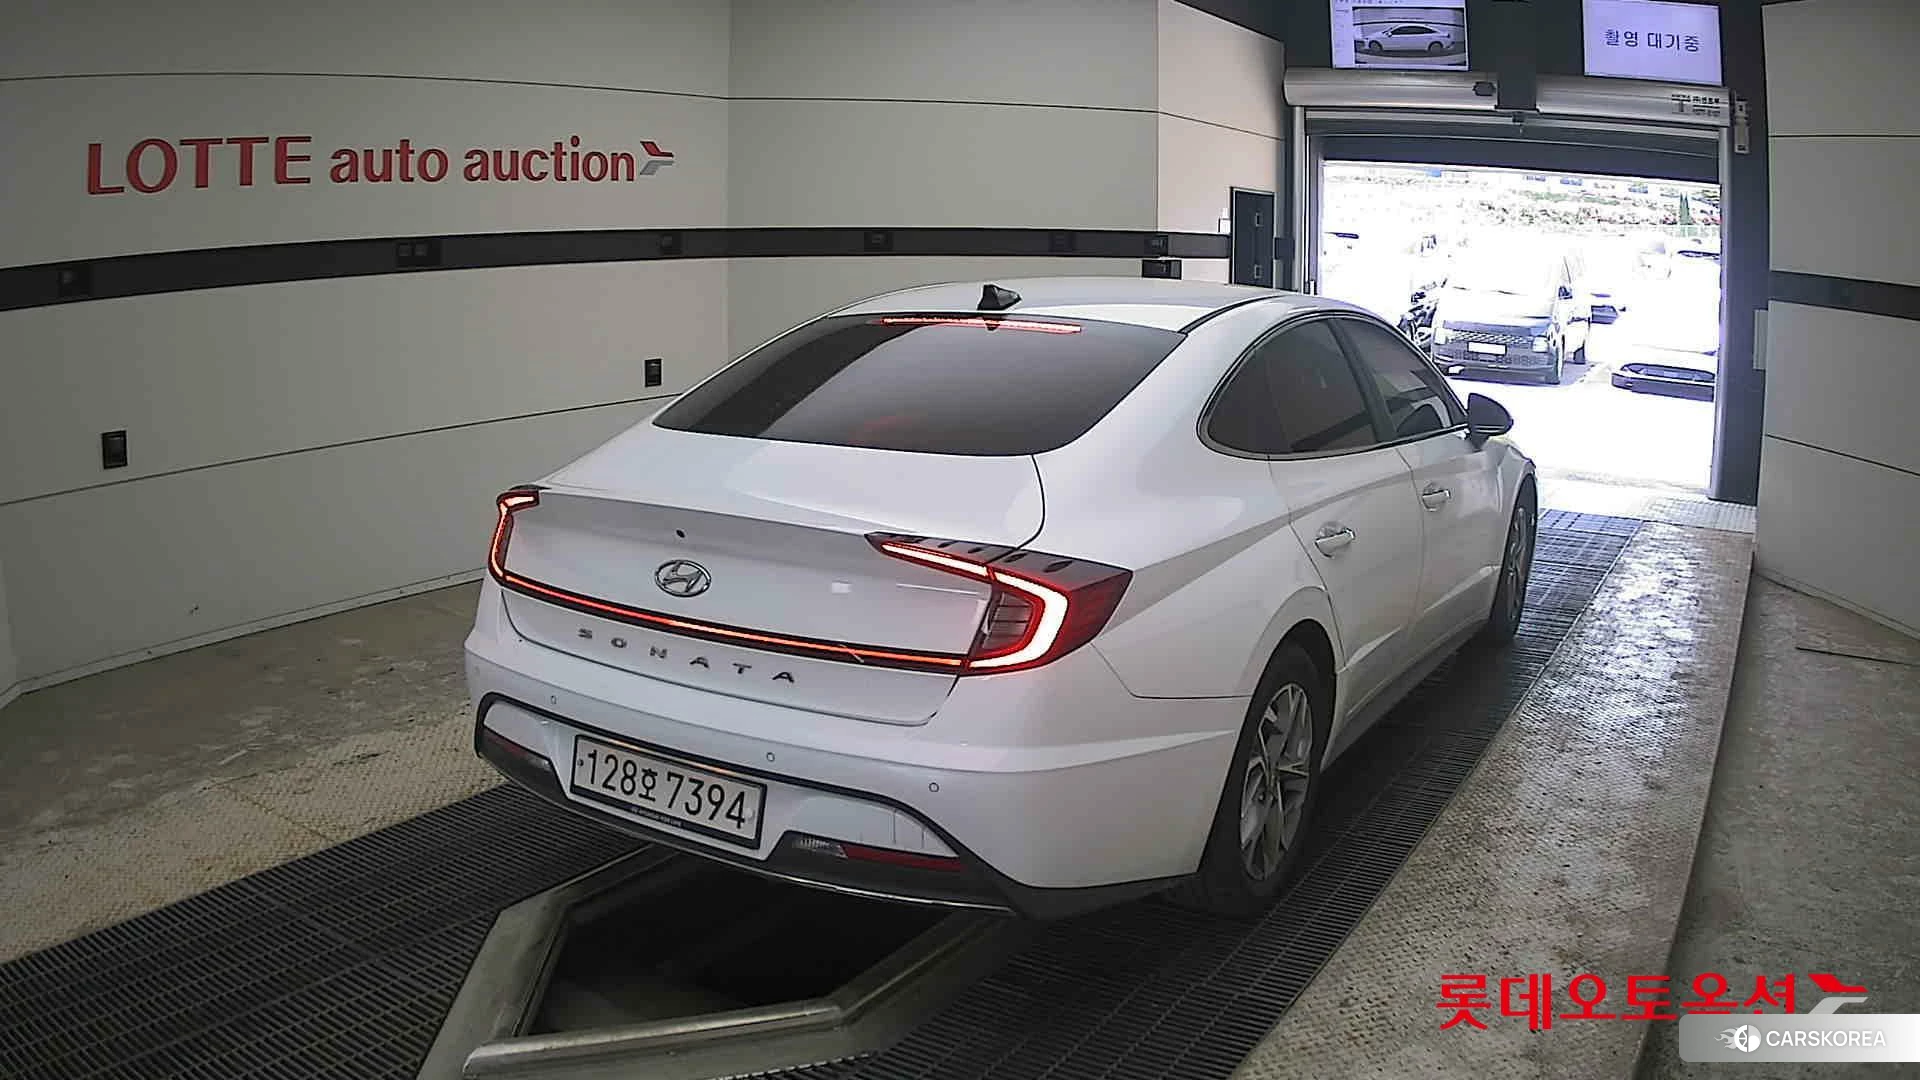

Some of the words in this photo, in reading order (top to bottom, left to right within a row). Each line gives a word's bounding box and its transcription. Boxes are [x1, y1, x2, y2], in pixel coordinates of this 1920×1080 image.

[1606, 28, 1638, 48] 촬영
[1647, 32, 1699, 52] 대기중
[87, 136, 312, 195] LOTTE
[329, 138, 449, 184] auto
[463, 136, 636, 183] auction
[578, 628, 795, 683] SONATA
[587, 749, 658, 802] 128호
[666, 771, 746, 829] 7394
